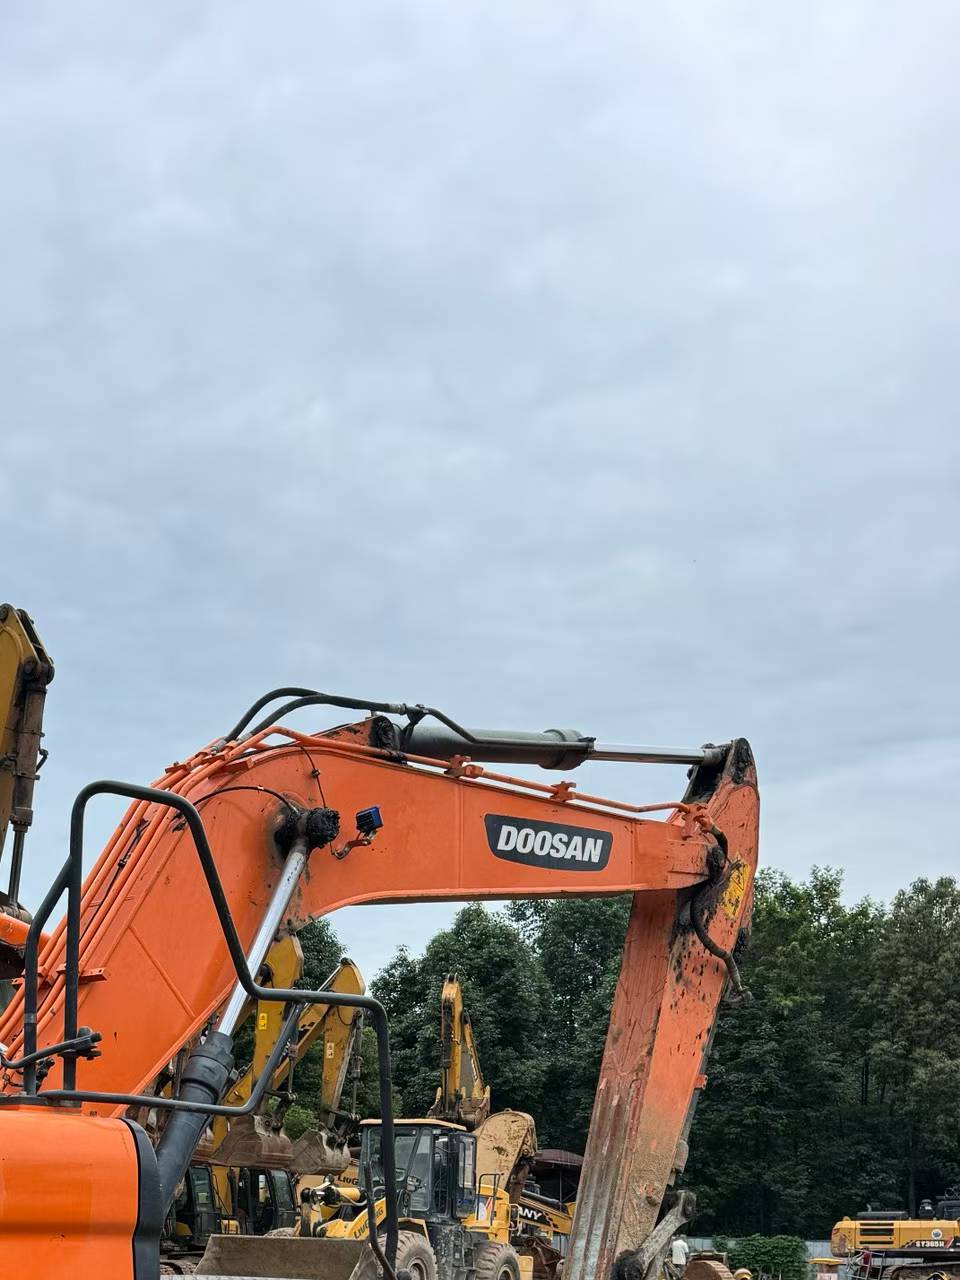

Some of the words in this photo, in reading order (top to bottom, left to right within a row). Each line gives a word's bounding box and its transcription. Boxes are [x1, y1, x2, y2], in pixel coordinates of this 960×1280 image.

[496, 824, 604, 863] DOOSAN
[338, 1174, 359, 1186] LIUG
[518, 1206, 543, 1220] ANY
